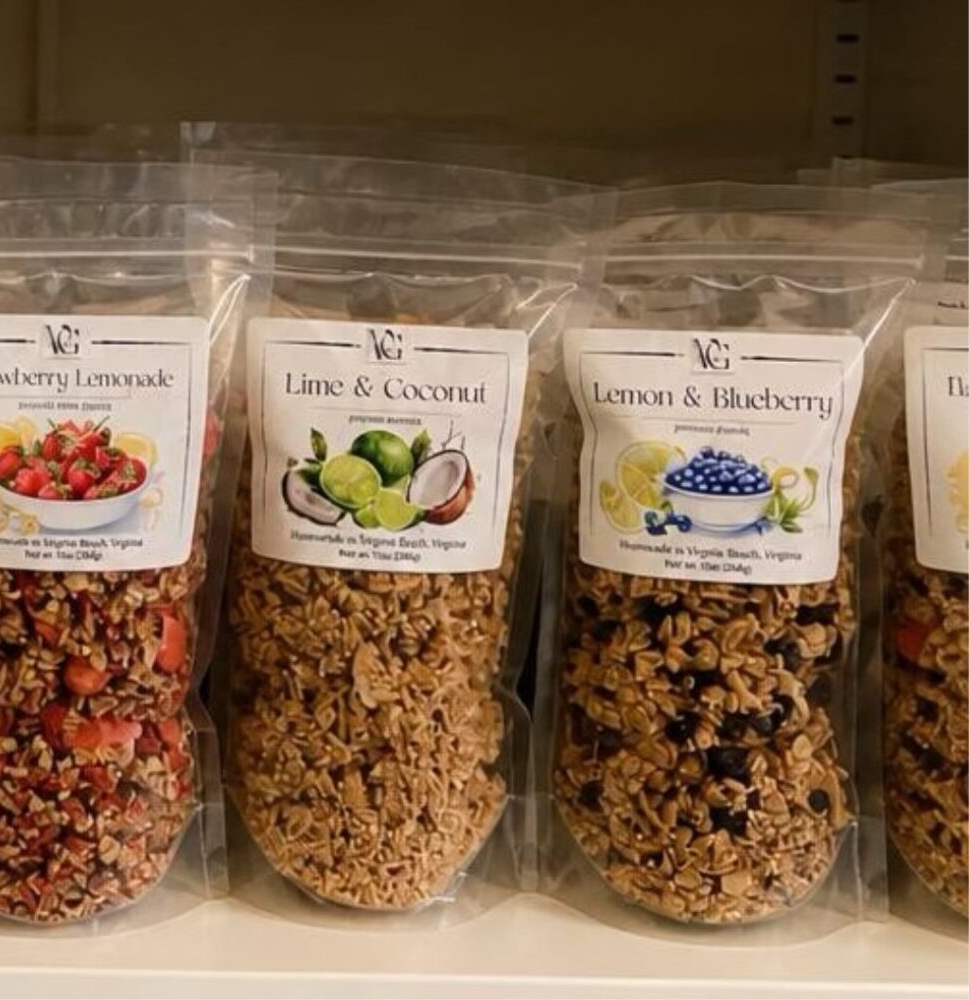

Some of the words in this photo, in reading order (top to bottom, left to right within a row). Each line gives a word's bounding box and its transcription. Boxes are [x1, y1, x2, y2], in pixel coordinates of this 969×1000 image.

[76, 368, 174, 388] Lemonade
[285, 372, 343, 397] Lime
[353, 374, 373, 398] &
[383, 378, 487, 404] Coconut
[593, 381, 673, 408] Lemon
[683, 385, 702, 408] &
[713, 386, 833, 420] Blueberry
